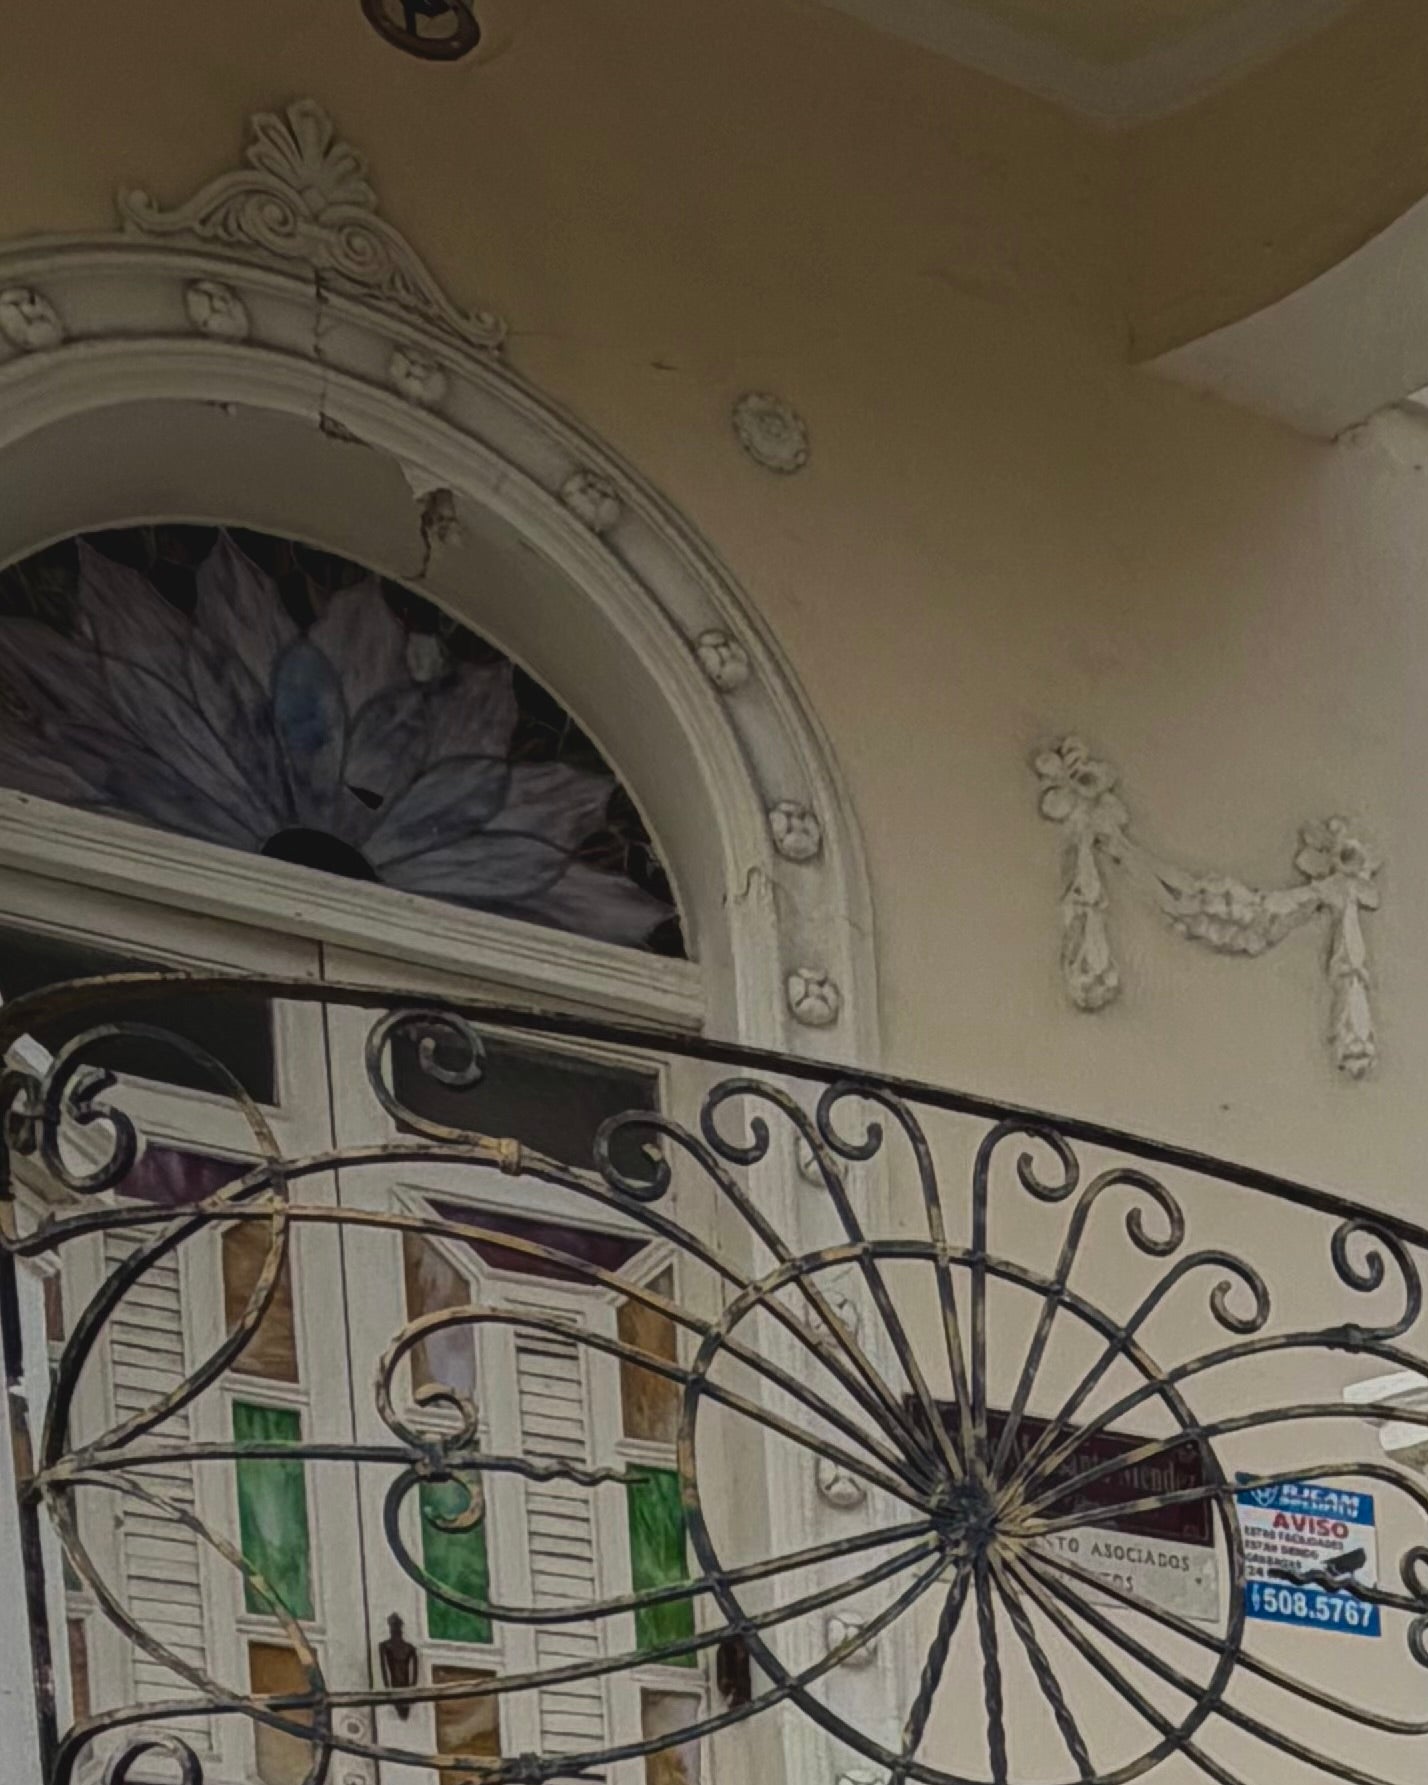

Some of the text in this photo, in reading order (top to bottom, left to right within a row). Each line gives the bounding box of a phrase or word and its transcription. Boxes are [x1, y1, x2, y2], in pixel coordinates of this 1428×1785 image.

[1272, 1511, 1350, 1539] AVISO
[1091, 1542, 1190, 1571] ASOCIADOS
[1262, 1586, 1374, 1628] 508.5767
